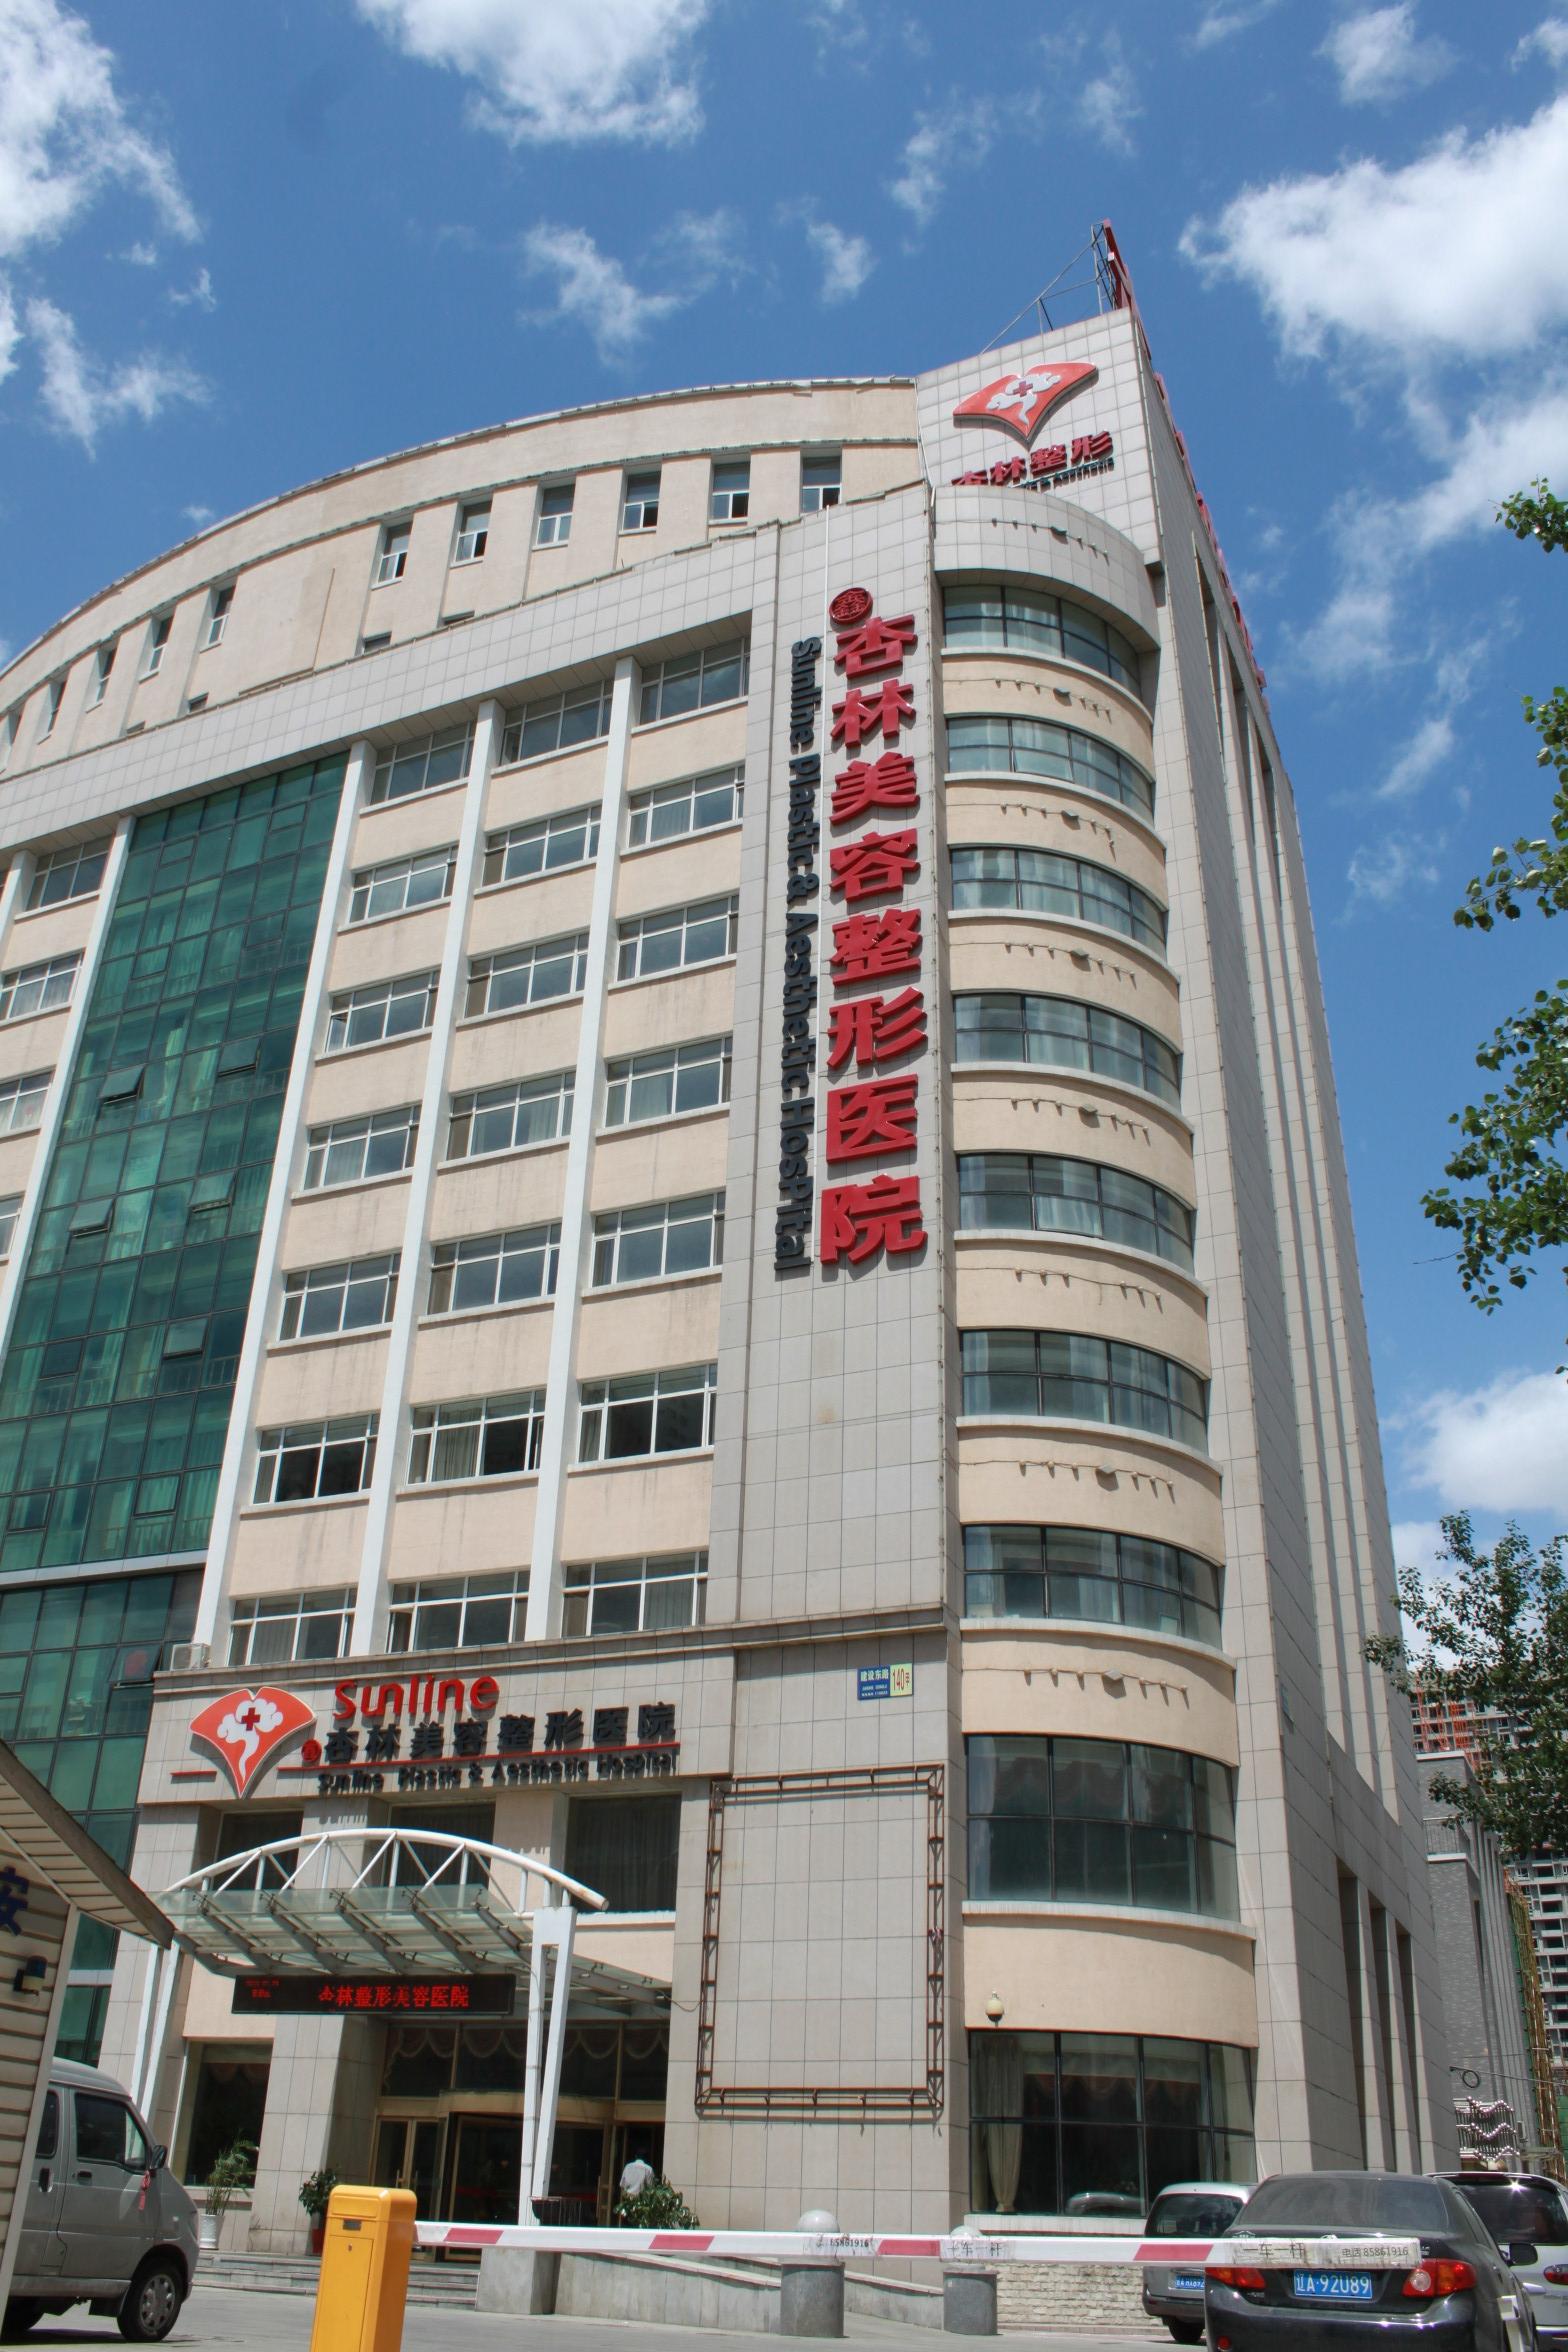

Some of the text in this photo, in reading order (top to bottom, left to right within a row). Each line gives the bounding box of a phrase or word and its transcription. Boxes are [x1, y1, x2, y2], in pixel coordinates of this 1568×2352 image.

[791, 636, 821, 754] Sunline
[788, 755, 820, 872] Plastic
[787, 873, 819, 904] &
[820, 613, 929, 1266] 杏林美容整形医院
[782, 911, 819, 1097] Aesthetic
[325, 1701, 676, 1764] 杏林美容整形医院
[332, 1675, 500, 1720] Sunline
